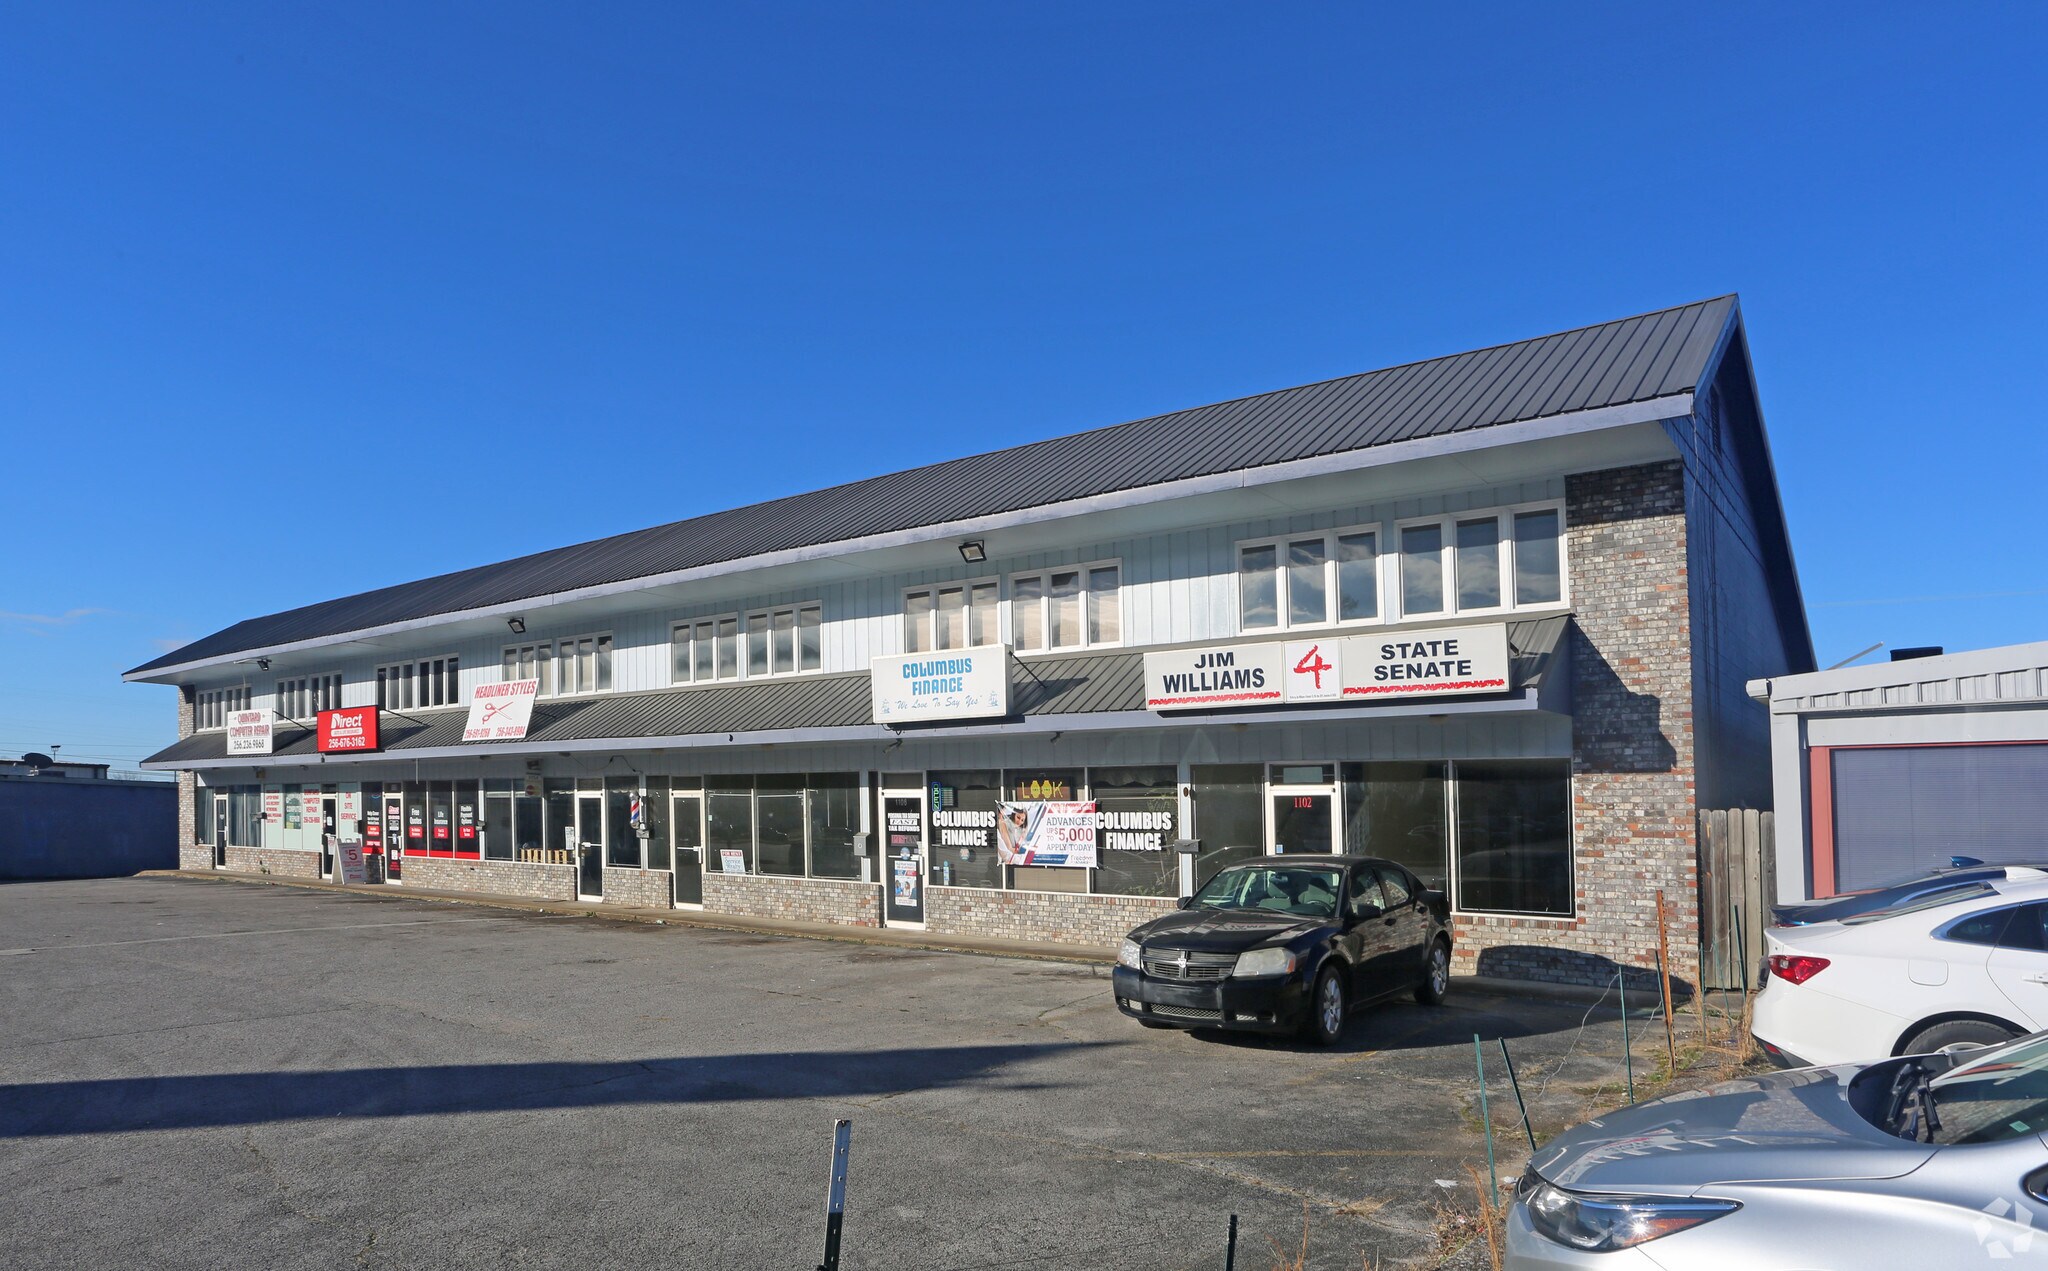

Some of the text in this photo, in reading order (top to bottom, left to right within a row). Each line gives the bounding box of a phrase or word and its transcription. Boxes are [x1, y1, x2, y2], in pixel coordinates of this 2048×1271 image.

[1381, 639, 1459, 660] STATE
[902, 658, 972, 679] COLUMBUS
[1194, 652, 1235, 669] JIM
[1293, 644, 1332, 689] 4
[1374, 660, 1472, 681] SENATE
[474, 681, 537, 699] HEADLINER STYLES
[912, 677, 963, 695] FINANCE
[1162, 668, 1265, 694] WILLIAMS
[911, 699, 928, 709] Love
[932, 697, 941, 707] To
[945, 696, 960, 707] Say
[238, 712, 261, 725] QUINTARD
[331, 713, 362, 728] Direct
[230, 725, 270, 737] COMPUTER REPAIR
[328, 737, 365, 748] 256-676-3162
[1022, 780, 1063, 798] LOOK
[1294, 797, 1312, 808] 1102
[932, 810, 996, 828] COLUMBUS
[1046, 817, 1093, 825] ADVANCES
[1096, 811, 1172, 830] COLUMBUS
[941, 829, 988, 847] FINANCE
[1106, 832, 1162, 851] FINANCE
